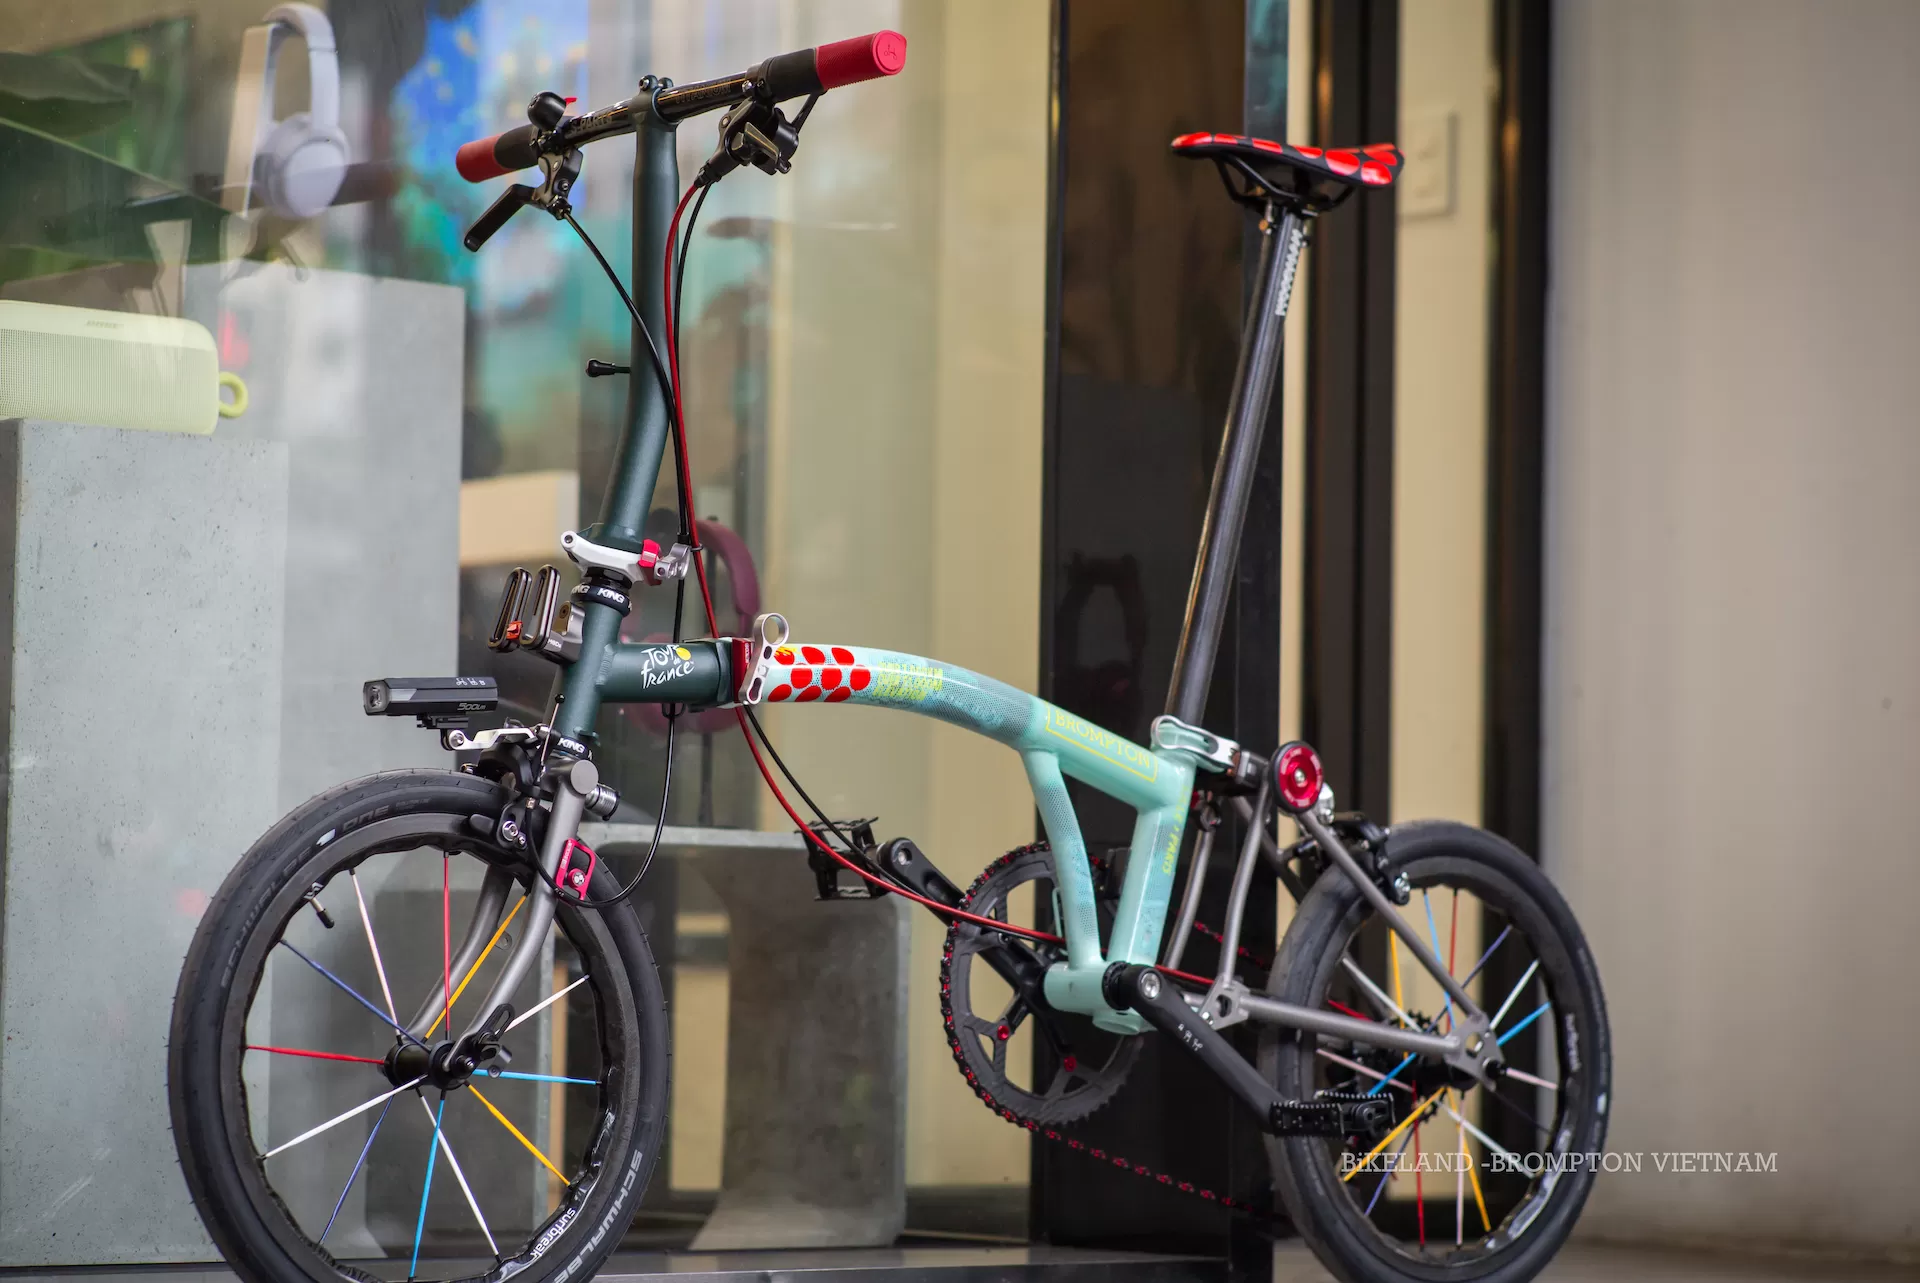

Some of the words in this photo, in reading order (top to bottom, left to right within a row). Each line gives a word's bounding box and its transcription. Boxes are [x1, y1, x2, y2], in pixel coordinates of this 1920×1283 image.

[597, 587, 626, 604] KING
[557, 737, 586, 754] KING
[1054, 708, 1151, 769] BROMPTON
[530, 1207, 576, 1258] surfbreak
[552, 1148, 644, 1283] SCHWALBE
